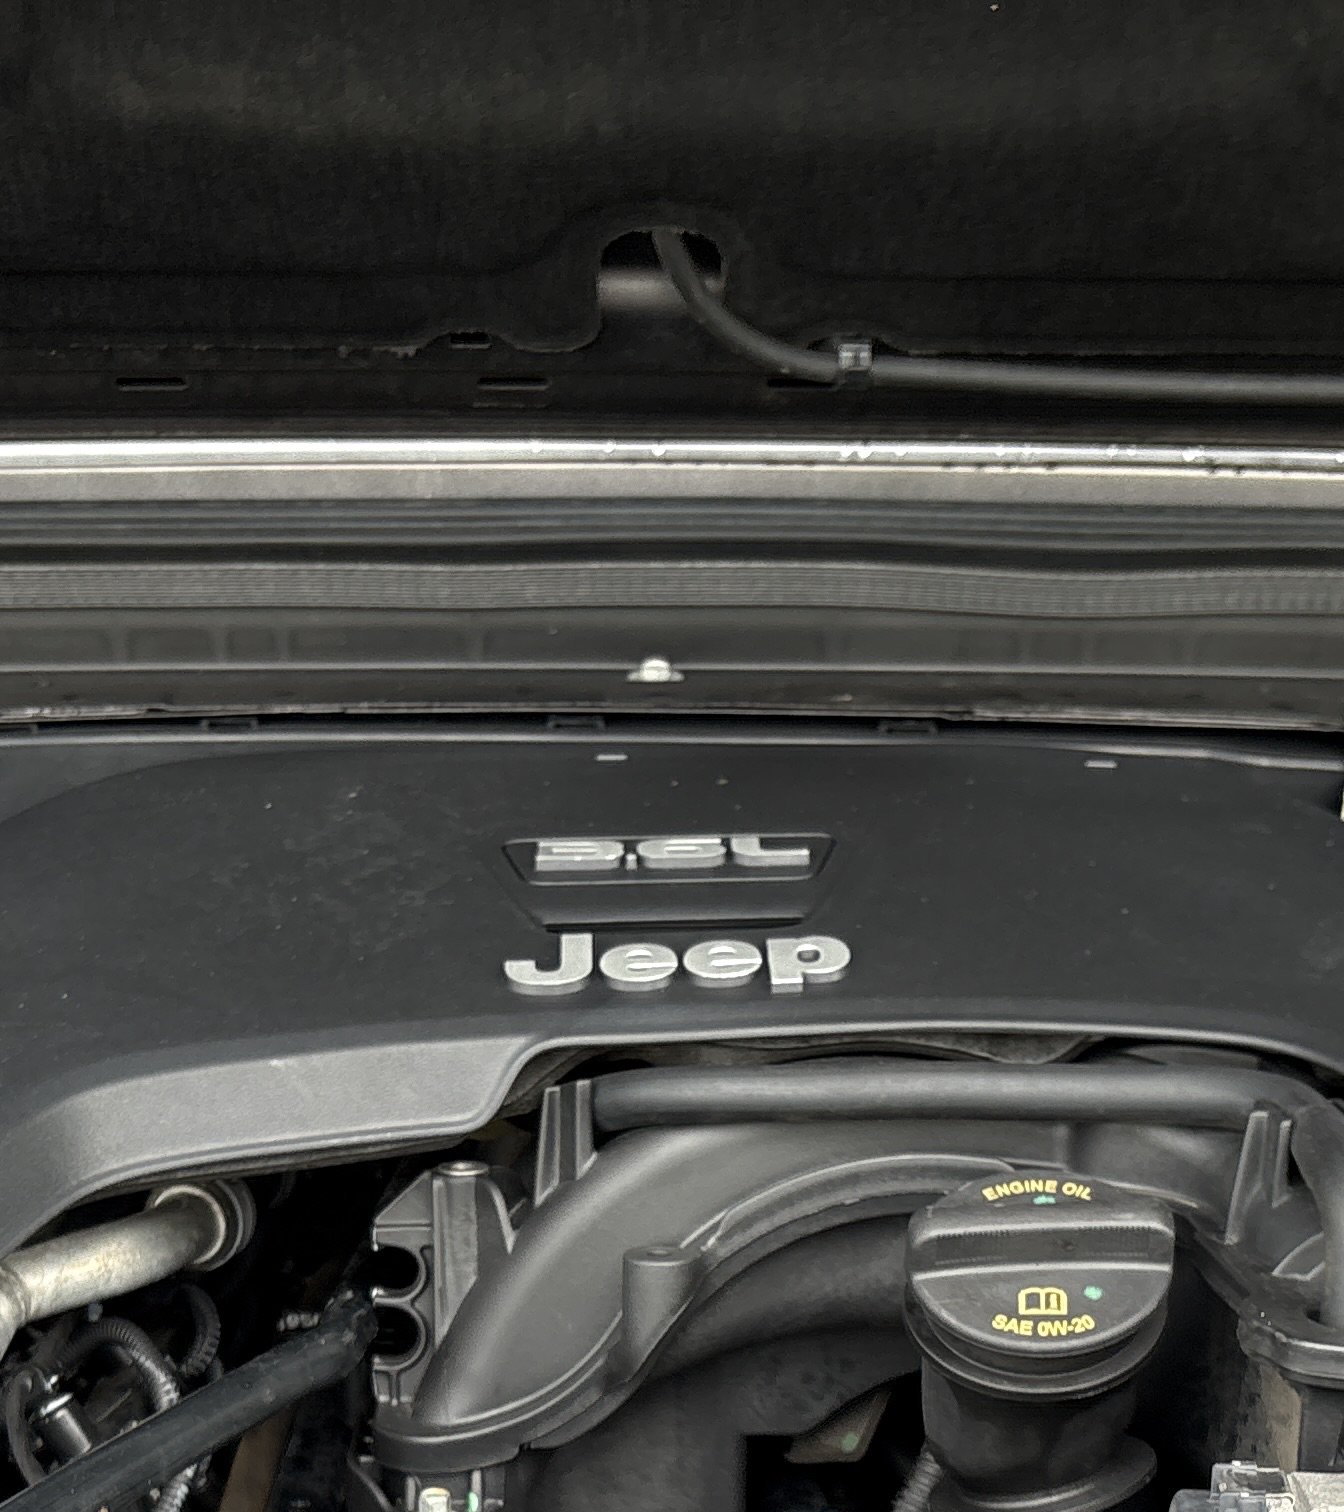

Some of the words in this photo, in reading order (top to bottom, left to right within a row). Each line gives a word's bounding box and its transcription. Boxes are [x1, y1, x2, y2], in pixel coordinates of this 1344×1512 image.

[503, 932, 852, 996] Jeep
[981, 1179, 1058, 1201] ENGINE
[1061, 1182, 1092, 1201] OIL
[991, 1314, 1034, 1336] SAE
[1037, 1314, 1096, 1337] 0W-20
